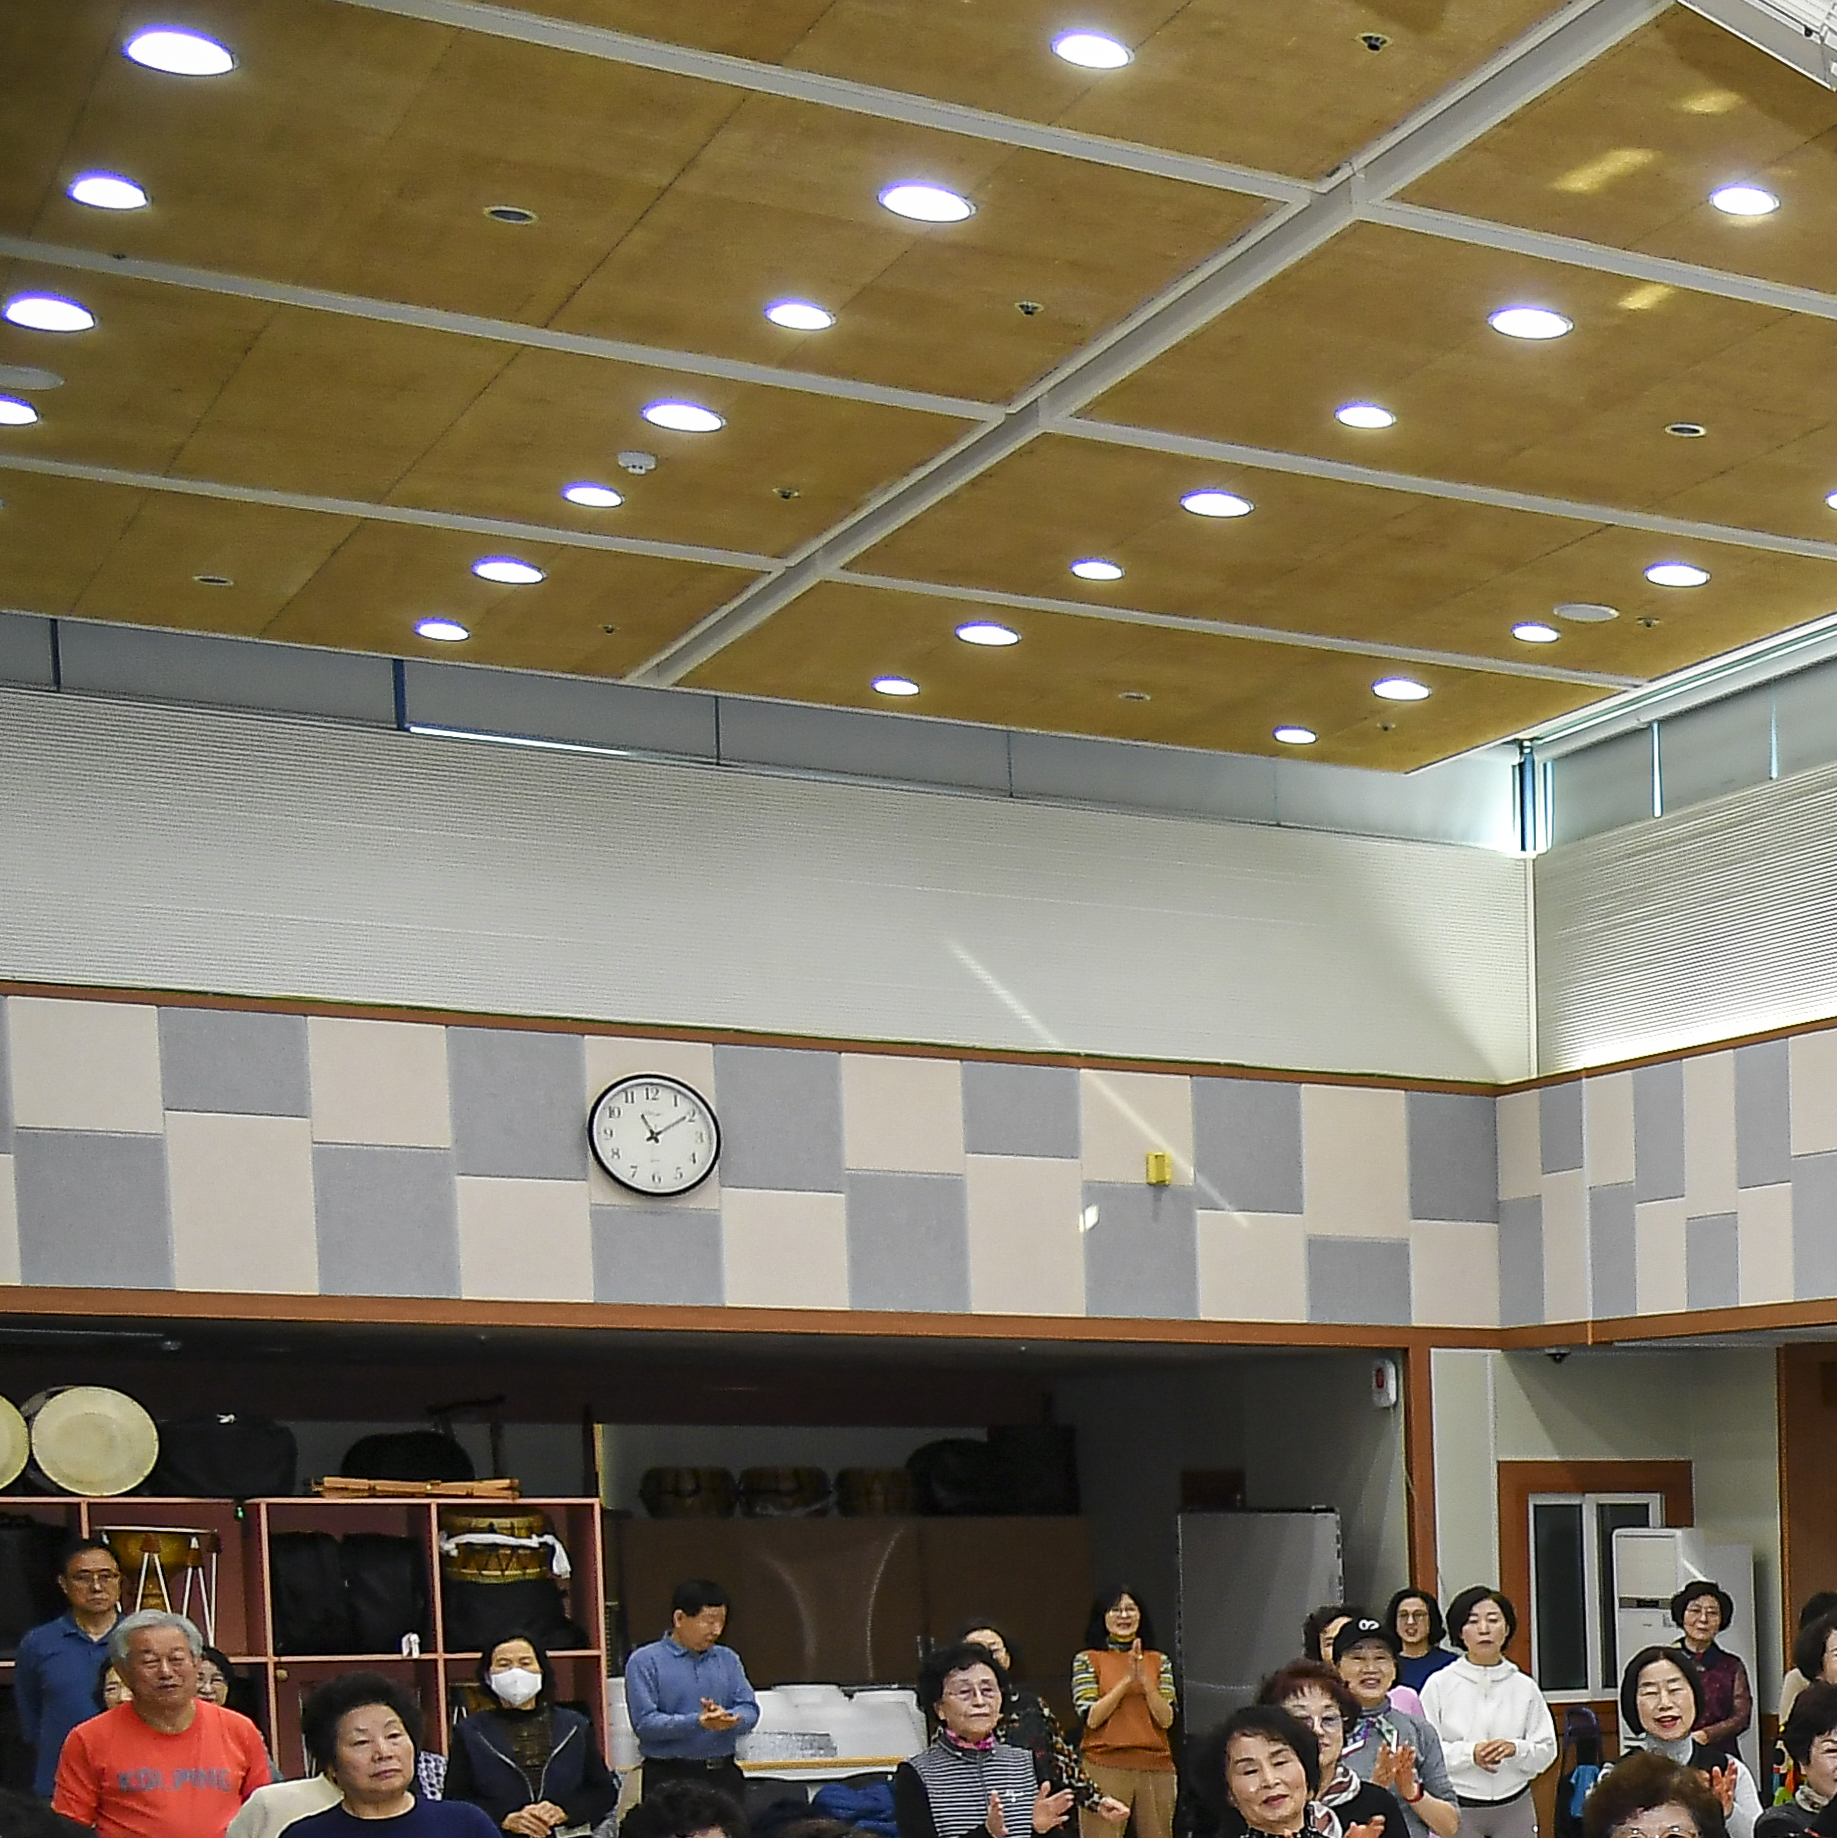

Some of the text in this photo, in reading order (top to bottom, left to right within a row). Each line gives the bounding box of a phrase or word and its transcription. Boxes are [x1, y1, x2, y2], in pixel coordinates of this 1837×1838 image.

[623, 1091, 636, 1104] 11
[644, 1087, 660, 1101] 12
[672, 1094, 680, 1107] 1
[607, 1105, 622, 1119] 10
[686, 1109, 696, 1123] 2
[603, 1128, 614, 1141] 9
[695, 1131, 705, 1144] 3
[610, 1147, 621, 1160] 8
[689, 1152, 697, 1165] 4
[629, 1165, 638, 1179] 7
[652, 1172, 662, 1184] 6
[674, 1168, 684, 1180] 5
